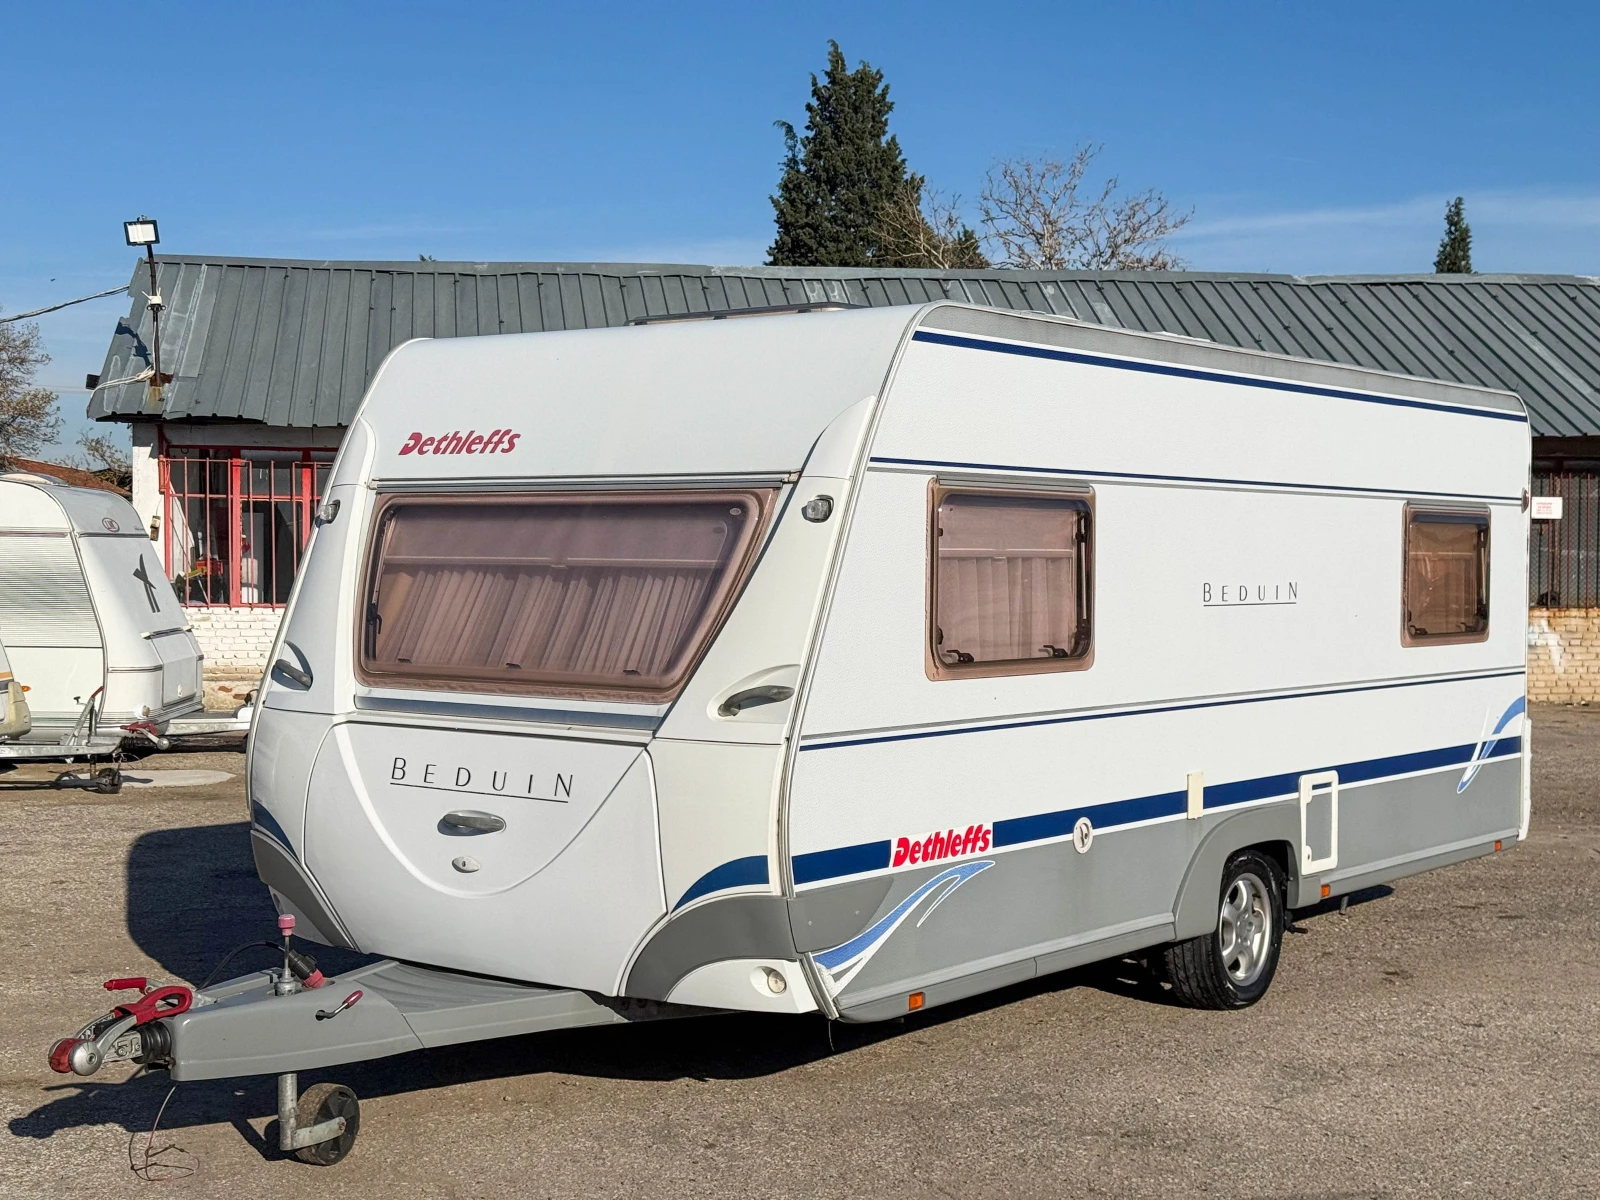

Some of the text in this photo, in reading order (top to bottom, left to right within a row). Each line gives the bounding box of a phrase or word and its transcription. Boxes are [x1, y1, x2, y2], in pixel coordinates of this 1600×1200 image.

[398, 428, 521, 456] Dethleffs
[1203, 582, 1297, 603] BEDUIN
[391, 757, 573, 797] BEDUIN
[892, 823, 992, 868] Dethleffs
